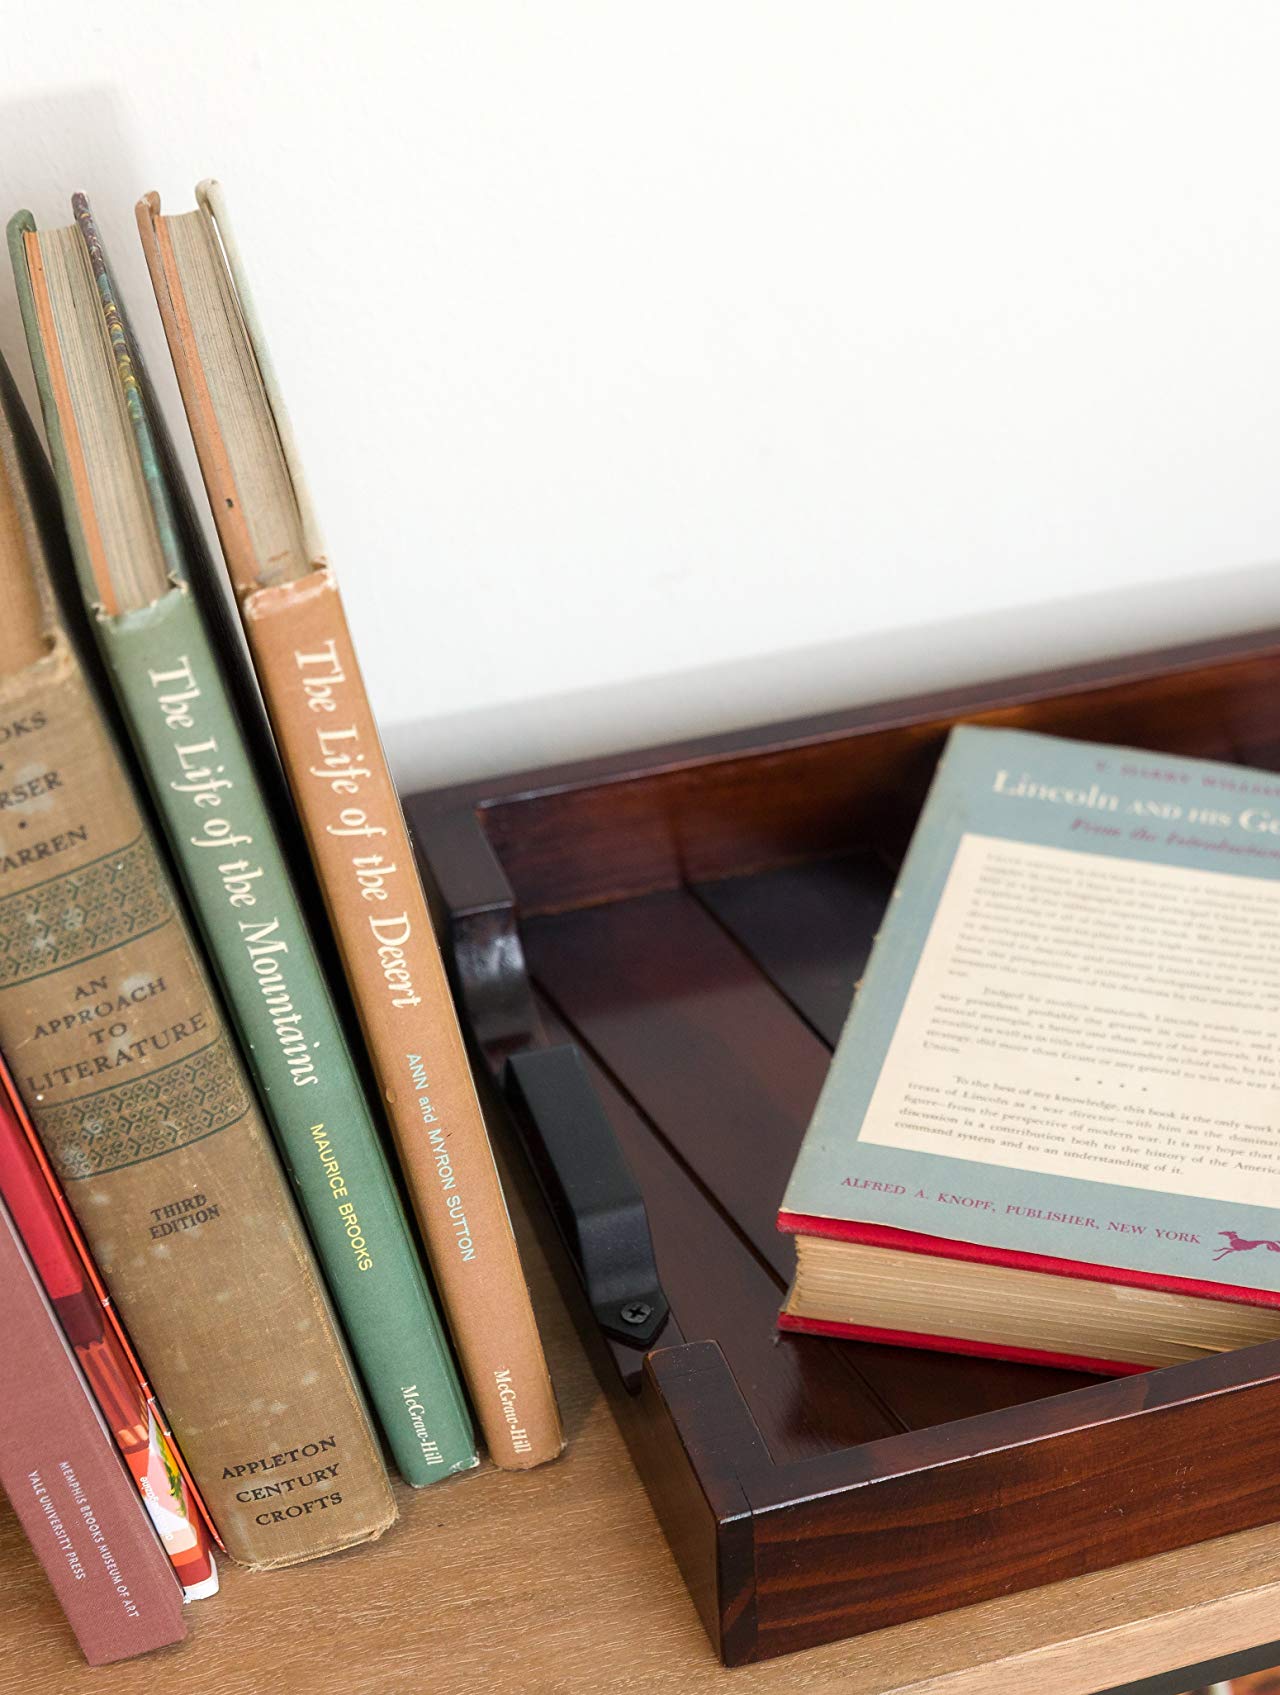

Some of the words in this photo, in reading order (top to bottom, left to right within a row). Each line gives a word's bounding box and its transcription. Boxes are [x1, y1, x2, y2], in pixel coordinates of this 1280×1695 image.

[147, 654, 201, 730] The
[294, 638, 347, 713] The
[170, 736, 233, 808] Life
[309, 723, 372, 794] Life
[991, 768, 1118, 812] Lincoln
[1123, 796, 1182, 821] AND
[190, 817, 253, 848] of
[326, 807, 387, 838] of
[218, 859, 264, 908] the
[352, 854, 397, 902] the
[368, 911, 423, 1009] Desert
[32, 977, 167, 1040] APPROACH
[74, 976, 109, 1001] AN
[238, 916, 320, 1087] Mountains
[26, 1012, 207, 1093] LITERATURE
[89, 1022, 128, 1046] TO
[907, 1081, 941, 1094] treats
[944, 1088, 958, 1097] of
[961, 1090, 1009, 1106] Lincoln
[1013, 1101, 1026, 1109] as
[1041, 1105, 1064, 1115] war
[1156, 1122, 1182, 1133] him
[1185, 1128, 1199, 1136] as
[1203, 1129, 1223, 1139] the
[970, 1079, 990, 1089] the
[992, 1082, 1017, 1094] best
[1017, 1087, 1032, 1096] of
[1032, 1090, 1051, 1100] my
[1122, 1104, 1145, 1115] this
[1147, 1107, 1176, 1119] book
[1179, 1112, 1190, 1121] is
[1192, 1114, 1212, 1124] the
[1213, 1119, 1241, 1129] only
[1243, 1123, 1273, 1133] work
[406, 1053, 430, 1090] ANN
[418, 1096, 438, 1124] and
[428, 1127, 456, 1191] MYRON
[446, 1194, 477, 1262] SUTTON
[893, 1120, 954, 1137] command
[956, 1131, 996, 1145] system
[999, 1139, 1024, 1150] and
[1026, 1143, 1040, 1152] to
[1042, 1147, 1059, 1156] an
[1062, 1150, 1150, 1171] understanding
[1152, 1163, 1168, 1173] of
[1170, 1165, 1184, 1175] it.
[898, 1106, 959, 1124] discussion
[963, 1117, 974, 1127] is
[989, 1124, 1066, 1143] contribution
[1070, 1135, 1099, 1148] both
[1103, 1142, 1116, 1151] to
[1120, 1144, 1140, 1154] the
[1144, 1147, 1186, 1163] history
[1190, 1155, 1205, 1164] of
[1208, 1157, 1229, 1168] the
[979, 1107, 999, 1118] the
[1000, 1112, 1068, 1129] perspective
[1070, 1123, 1085, 1132] of
[1086, 1127, 1134, 1140] modern
[1137, 1134, 1162, 1144] war.
[1166, 1137, 1177, 1146] It
[1180, 1140, 1191, 1149] is
[1193, 1143, 1212, 1152] my
[1215, 1144, 1246, 1157] hope
[1248, 1149, 1273, 1160] that
[148, 1204, 221, 1240] EDITION
[150, 1193, 208, 1222] THIRD
[310, 1123, 348, 1199] MAURICE
[337, 1202, 373, 1271] BROOKS
[841, 1175, 906, 1196] ALFRED
[915, 1188, 930, 1201] A.
[937, 1191, 997, 1215] KNOPF,
[1006, 1204, 1101, 1231] PUBLISHER,
[1107, 1220, 1148, 1236] NEW
[1154, 1228, 1202, 1246] YORK
[400, 1384, 444, 1466] McGraw-Hill
[494, 1368, 533, 1454] McGraw-Hill
[58, 1460, 88, 1506] MEMPHIS
[222, 1435, 337, 1480] APPLETON
[235, 1462, 341, 1504] CENTURY
[27, 1469, 45, 1496] YALE
[38, 1495, 73, 1551] UNIVERSITY
[65, 1551, 87, 1582] PRESS
[80, 1504, 106, 1549] BROOKS
[255, 1491, 344, 1526] CROFTS
[98, 1543, 124, 1586] MUSEUM
[116, 1585, 130, 1598] OF
[122, 1598, 140, 1618] ART
